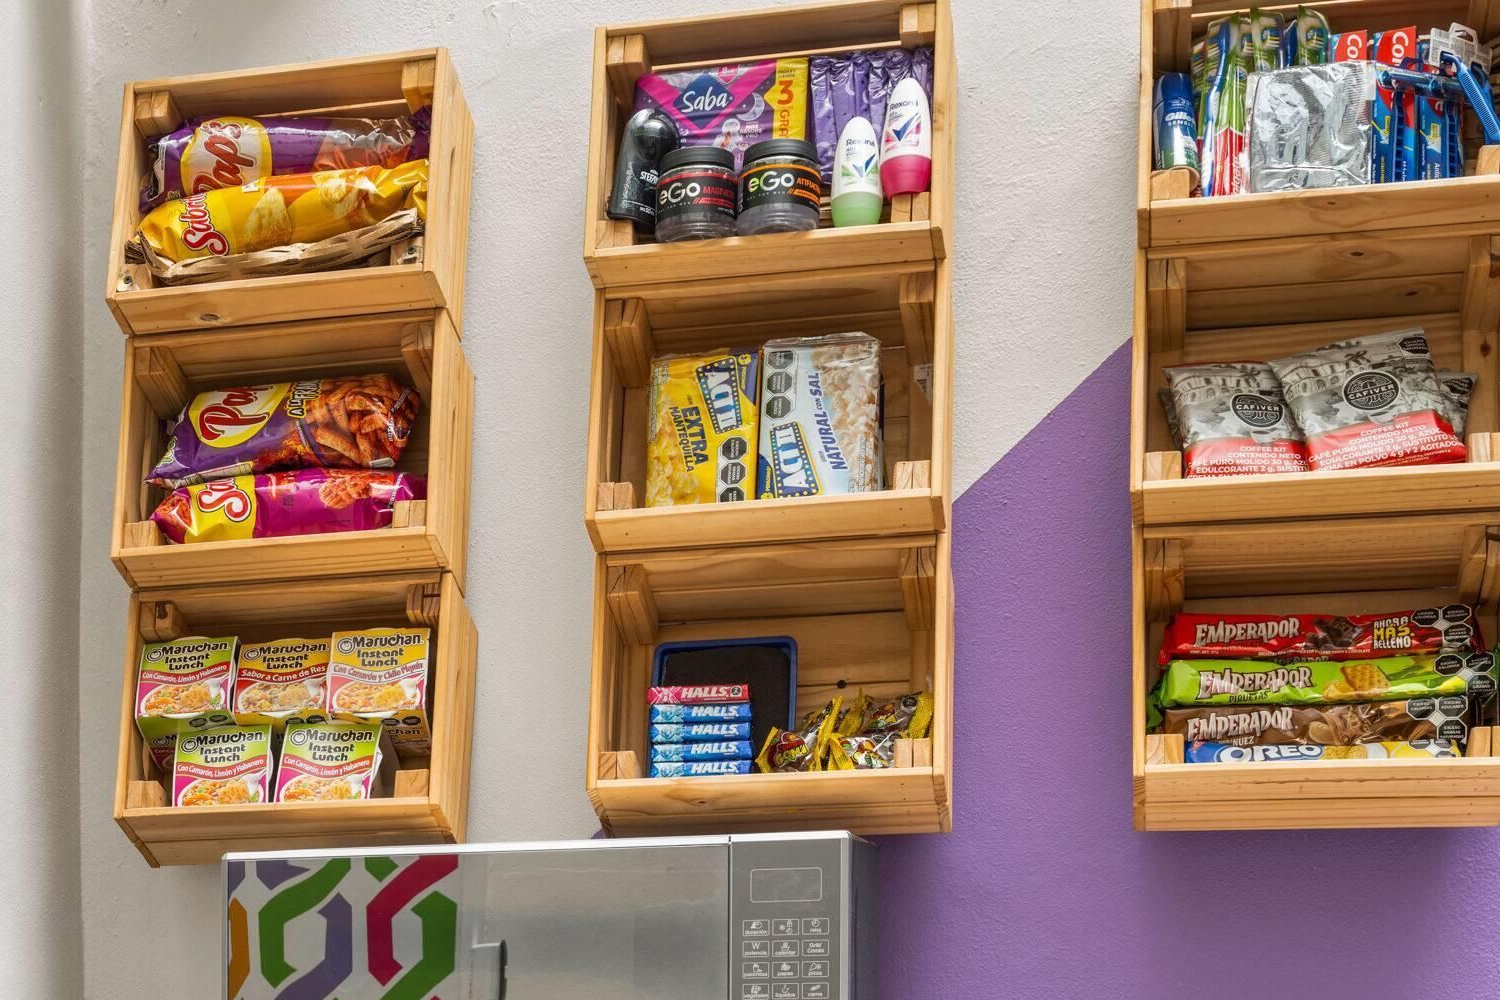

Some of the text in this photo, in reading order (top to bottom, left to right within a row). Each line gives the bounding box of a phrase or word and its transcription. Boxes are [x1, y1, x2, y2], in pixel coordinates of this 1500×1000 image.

[682, 86, 729, 113] Saba
[1349, 384, 1395, 400] CAFIVER
[808, 372, 848, 470] NATURAL CON SAL
[681, 406, 709, 465] EXTRA
[1349, 425, 1425, 444] CONTENIDO NETO
[1360, 425, 1394, 436] COFFEE
[670, 406, 695, 472] MANTEQUILLA
[1332, 444, 1358, 456] PURO
[1357, 437, 1394, 451] MOLIDO
[1320, 446, 1385, 466] EDULCORANTE
[1196, 465, 1259, 473] EDULCORANTE
[1373, 616, 1409, 628] AHORA
[1195, 617, 1301, 647] EMPERADOR
[353, 633, 421, 648] Maruchan
[1373, 635, 1412, 649] RELLENO
[162, 642, 228, 655] Maruchan
[260, 643, 327, 655] Maruchan
[357, 648, 404, 659] Instant
[165, 653, 210, 664] Instant
[263, 653, 309, 663] Instant
[362, 657, 398, 667] Lunch
[169, 661, 204, 671] Lunch
[267, 661, 303, 670] Lunch
[178, 674, 196, 683] Limón
[200, 665, 227, 677] Habanero
[242, 669, 264, 679] Sabor
[272, 673, 298, 681] Carne
[299, 669, 310, 677] de
[310, 665, 326, 674] Res
[1198, 666, 1312, 700] EMPERADOR
[681, 687, 729, 699] HALLS
[1229, 691, 1269, 704] PIRUETAS
[691, 706, 739, 717] HALLS
[691, 724, 739, 735] HALLS
[1187, 706, 1294, 741] EMPERADOR
[197, 731, 263, 745] Maruchan
[306, 728, 373, 741] Maruchan
[309, 742, 355, 753] Instant
[691, 742, 739, 754] HALLS
[1232, 736, 1255, 747] NUEZ
[200, 744, 246, 755] Instant
[1219, 744, 1323, 763] OREO
[205, 753, 240, 763] Lunch
[312, 752, 348, 761] Lunch
[214, 767, 233, 777] Limón
[237, 759, 264, 772] Habanero
[320, 767, 339, 776] Limón
[343, 759, 370, 773] Habanero
[691, 761, 739, 774] HALLS
